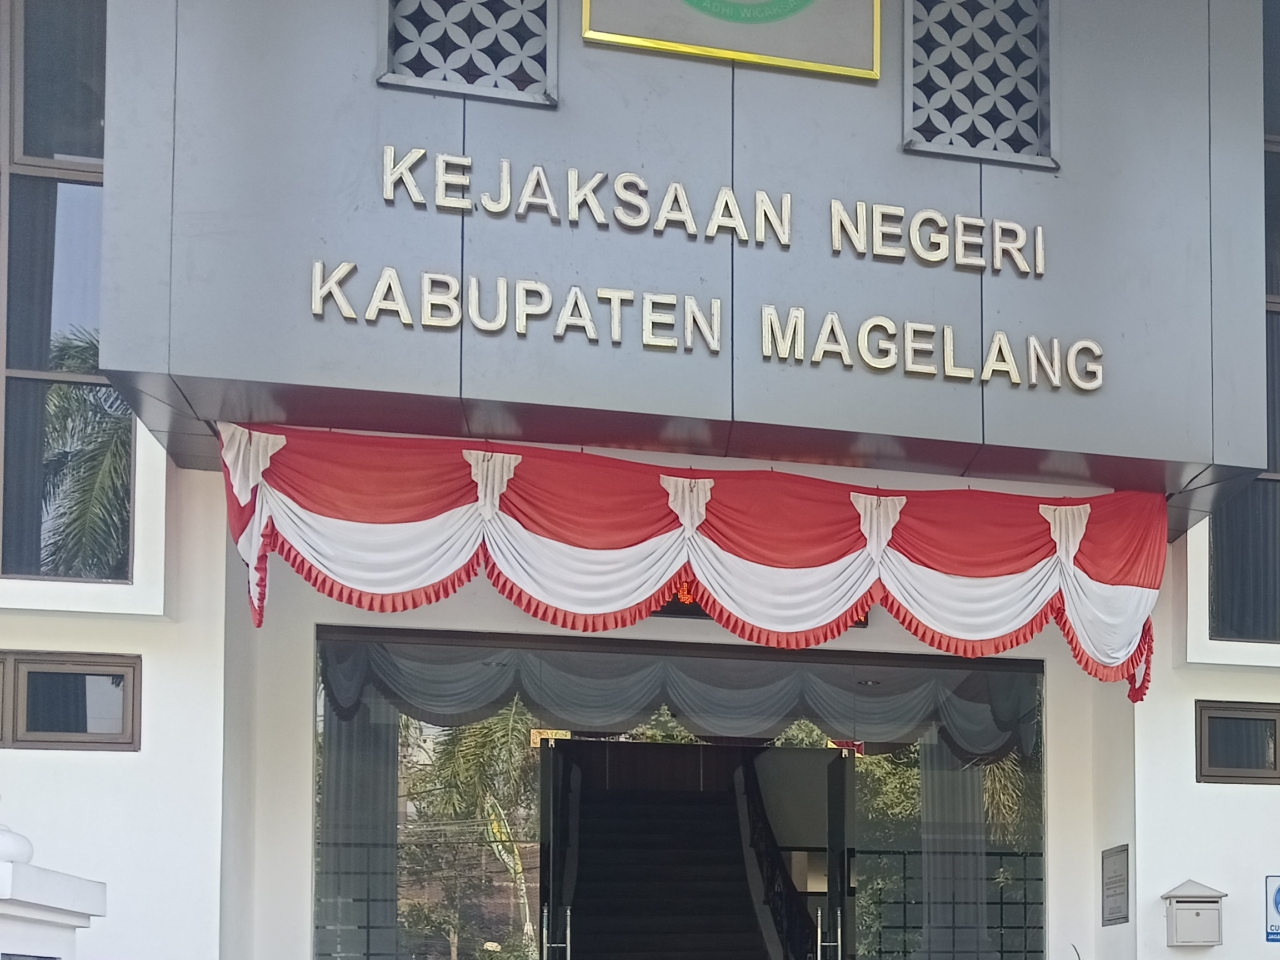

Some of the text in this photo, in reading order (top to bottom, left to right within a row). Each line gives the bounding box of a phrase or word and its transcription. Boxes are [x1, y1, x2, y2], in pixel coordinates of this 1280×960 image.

[382, 145, 1045, 276] KEJAKSAAN NEGERI
[311, 259, 1104, 391] KABUPATEN MAGELANG
